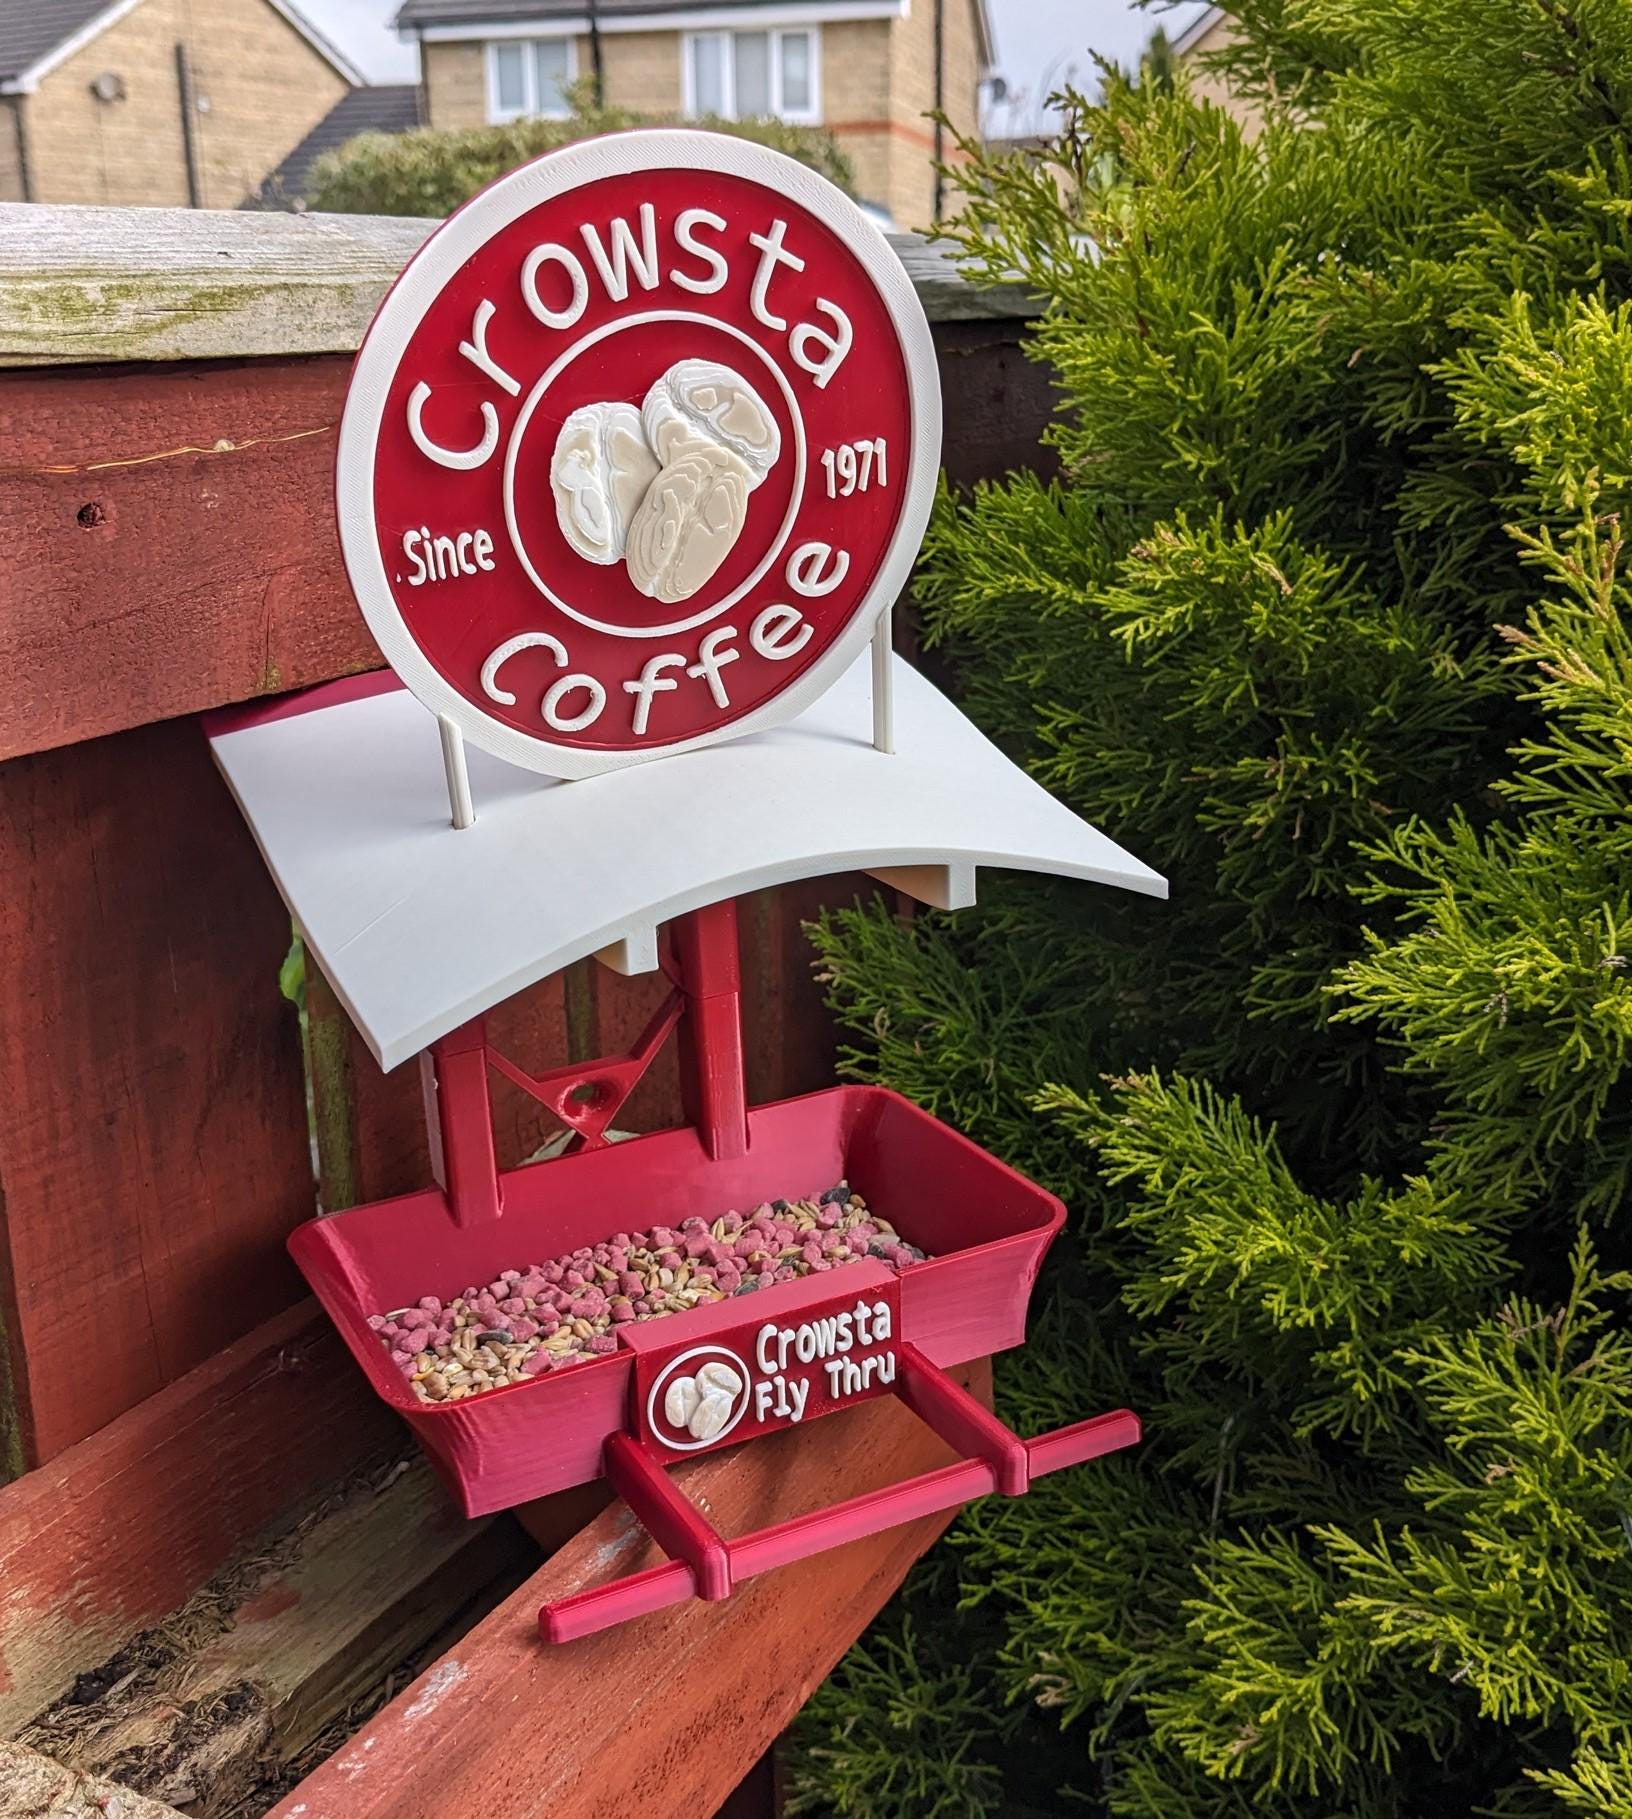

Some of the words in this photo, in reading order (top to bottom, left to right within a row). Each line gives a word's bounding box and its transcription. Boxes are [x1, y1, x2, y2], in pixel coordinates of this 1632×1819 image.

[406, 201, 854, 470] Crowsta
[402, 526, 496, 586] Since
[820, 437, 887, 499] 1971
[480, 541, 850, 735] Coffee
[755, 1300, 892, 1375] Crowsta
[755, 1375, 810, 1423] Fly
[824, 1351, 896, 1399] Thru
